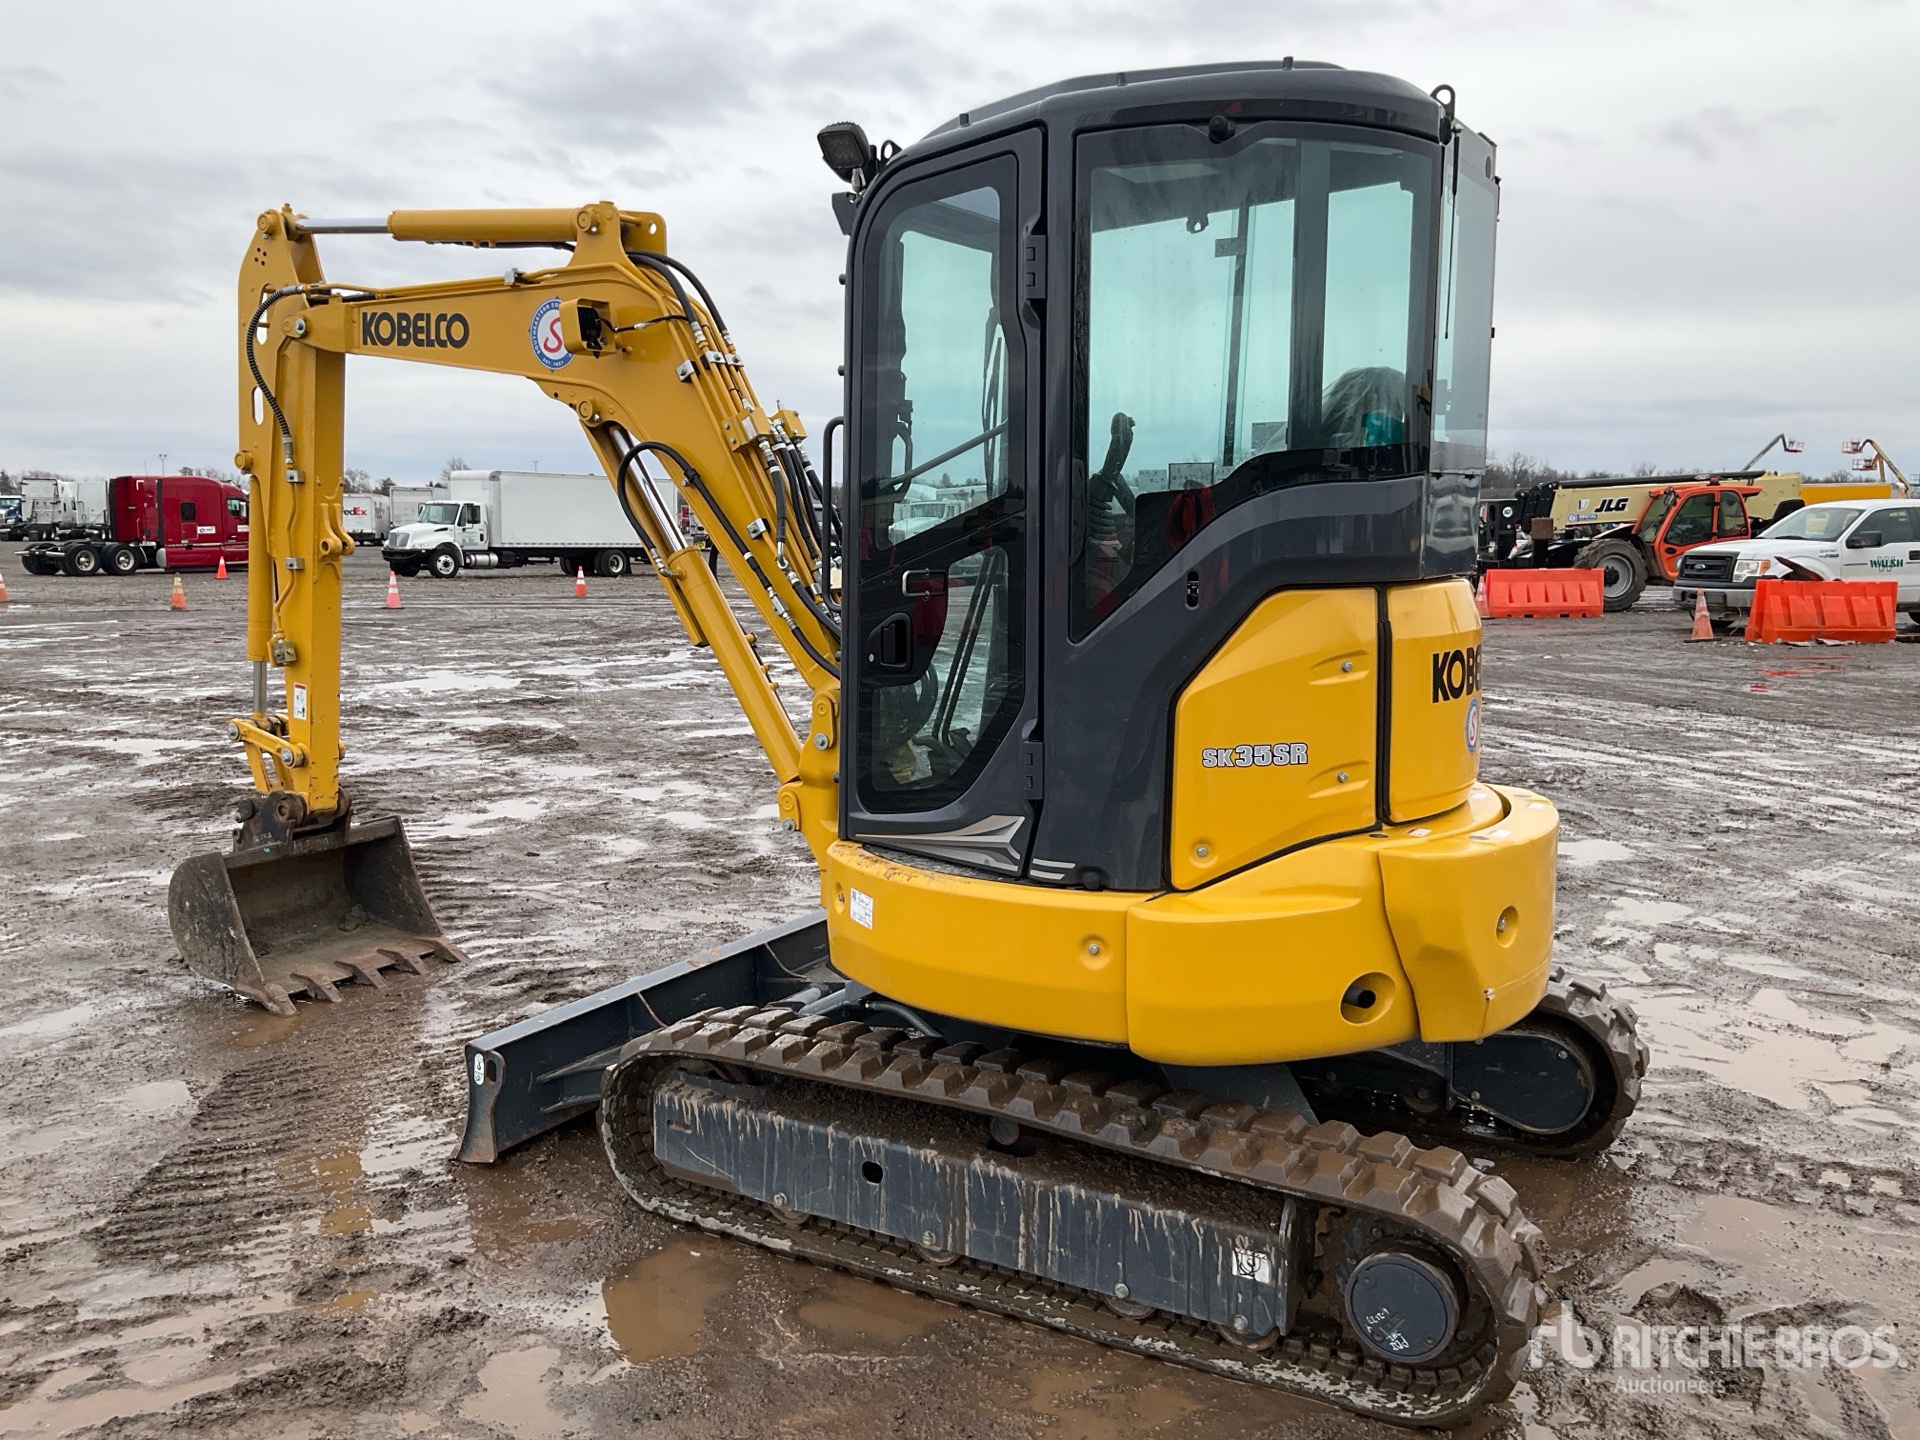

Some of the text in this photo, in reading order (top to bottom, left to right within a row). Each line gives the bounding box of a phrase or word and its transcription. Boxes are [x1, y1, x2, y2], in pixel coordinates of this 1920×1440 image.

[362, 311, 470, 349] KOBELCO
[1594, 497, 1629, 513] JLG
[1869, 559, 1904, 568] WALSH
[1202, 743, 1308, 768] SK35SR
